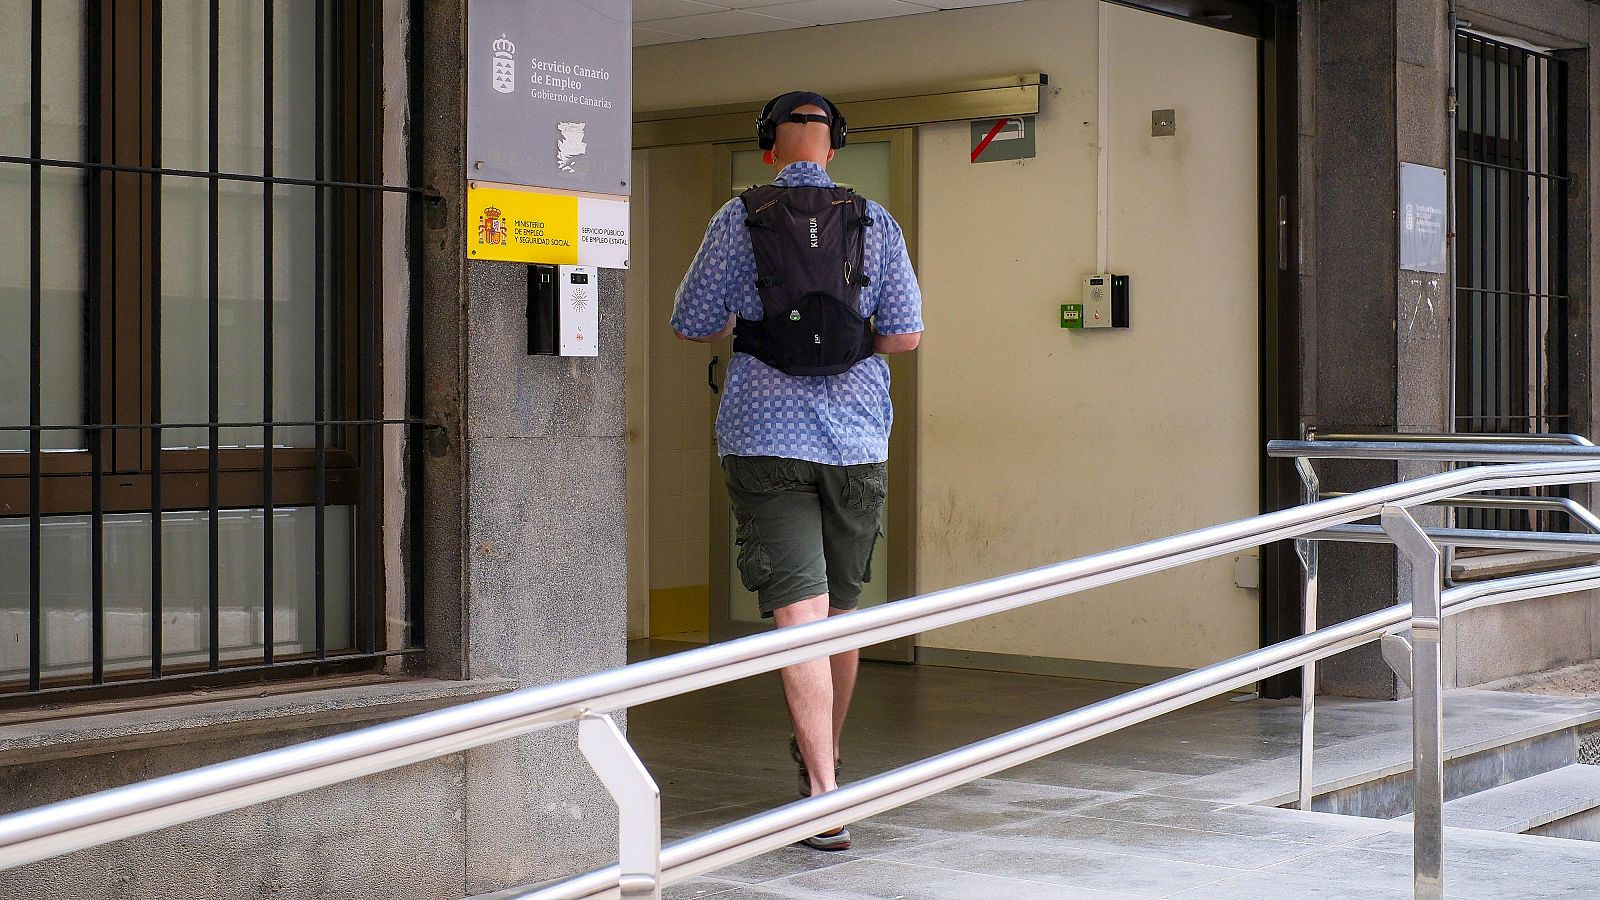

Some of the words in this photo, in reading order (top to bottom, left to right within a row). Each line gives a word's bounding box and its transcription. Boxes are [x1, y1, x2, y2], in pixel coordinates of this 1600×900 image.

[531, 58, 571, 74] Servicio
[573, 65, 610, 80] Canario
[531, 72, 543, 84] de
[545, 74, 582, 90] Empleo
[531, 88, 568, 102] Gobierno
[569, 94, 578, 104] de
[579, 95, 612, 108] Canarias
[514, 220, 545, 229] MINISTERIO
[809, 217, 819, 248] KIPRUN
[519, 236, 550, 245] SEGURIDAD
[550, 238, 571, 247] SOCIAL
[589, 236, 608, 244] EMPLEO
